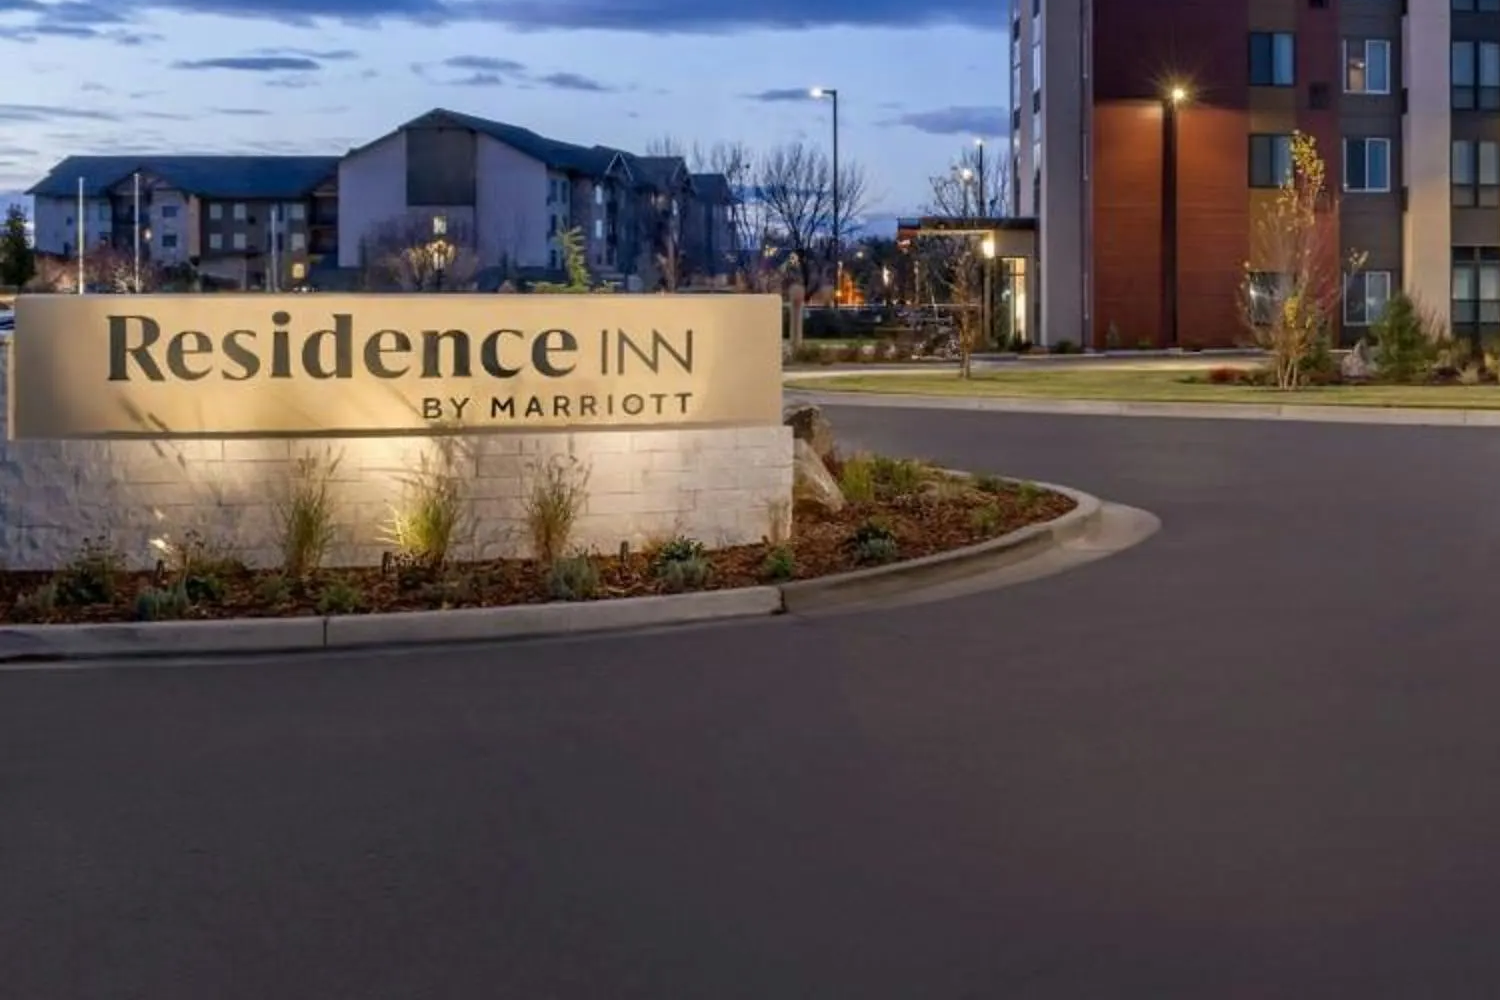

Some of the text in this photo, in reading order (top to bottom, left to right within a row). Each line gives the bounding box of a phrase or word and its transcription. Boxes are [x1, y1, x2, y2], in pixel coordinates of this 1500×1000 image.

[106, 310, 694, 382] Residence INN
[422, 392, 694, 420] BY MARRIOTT
